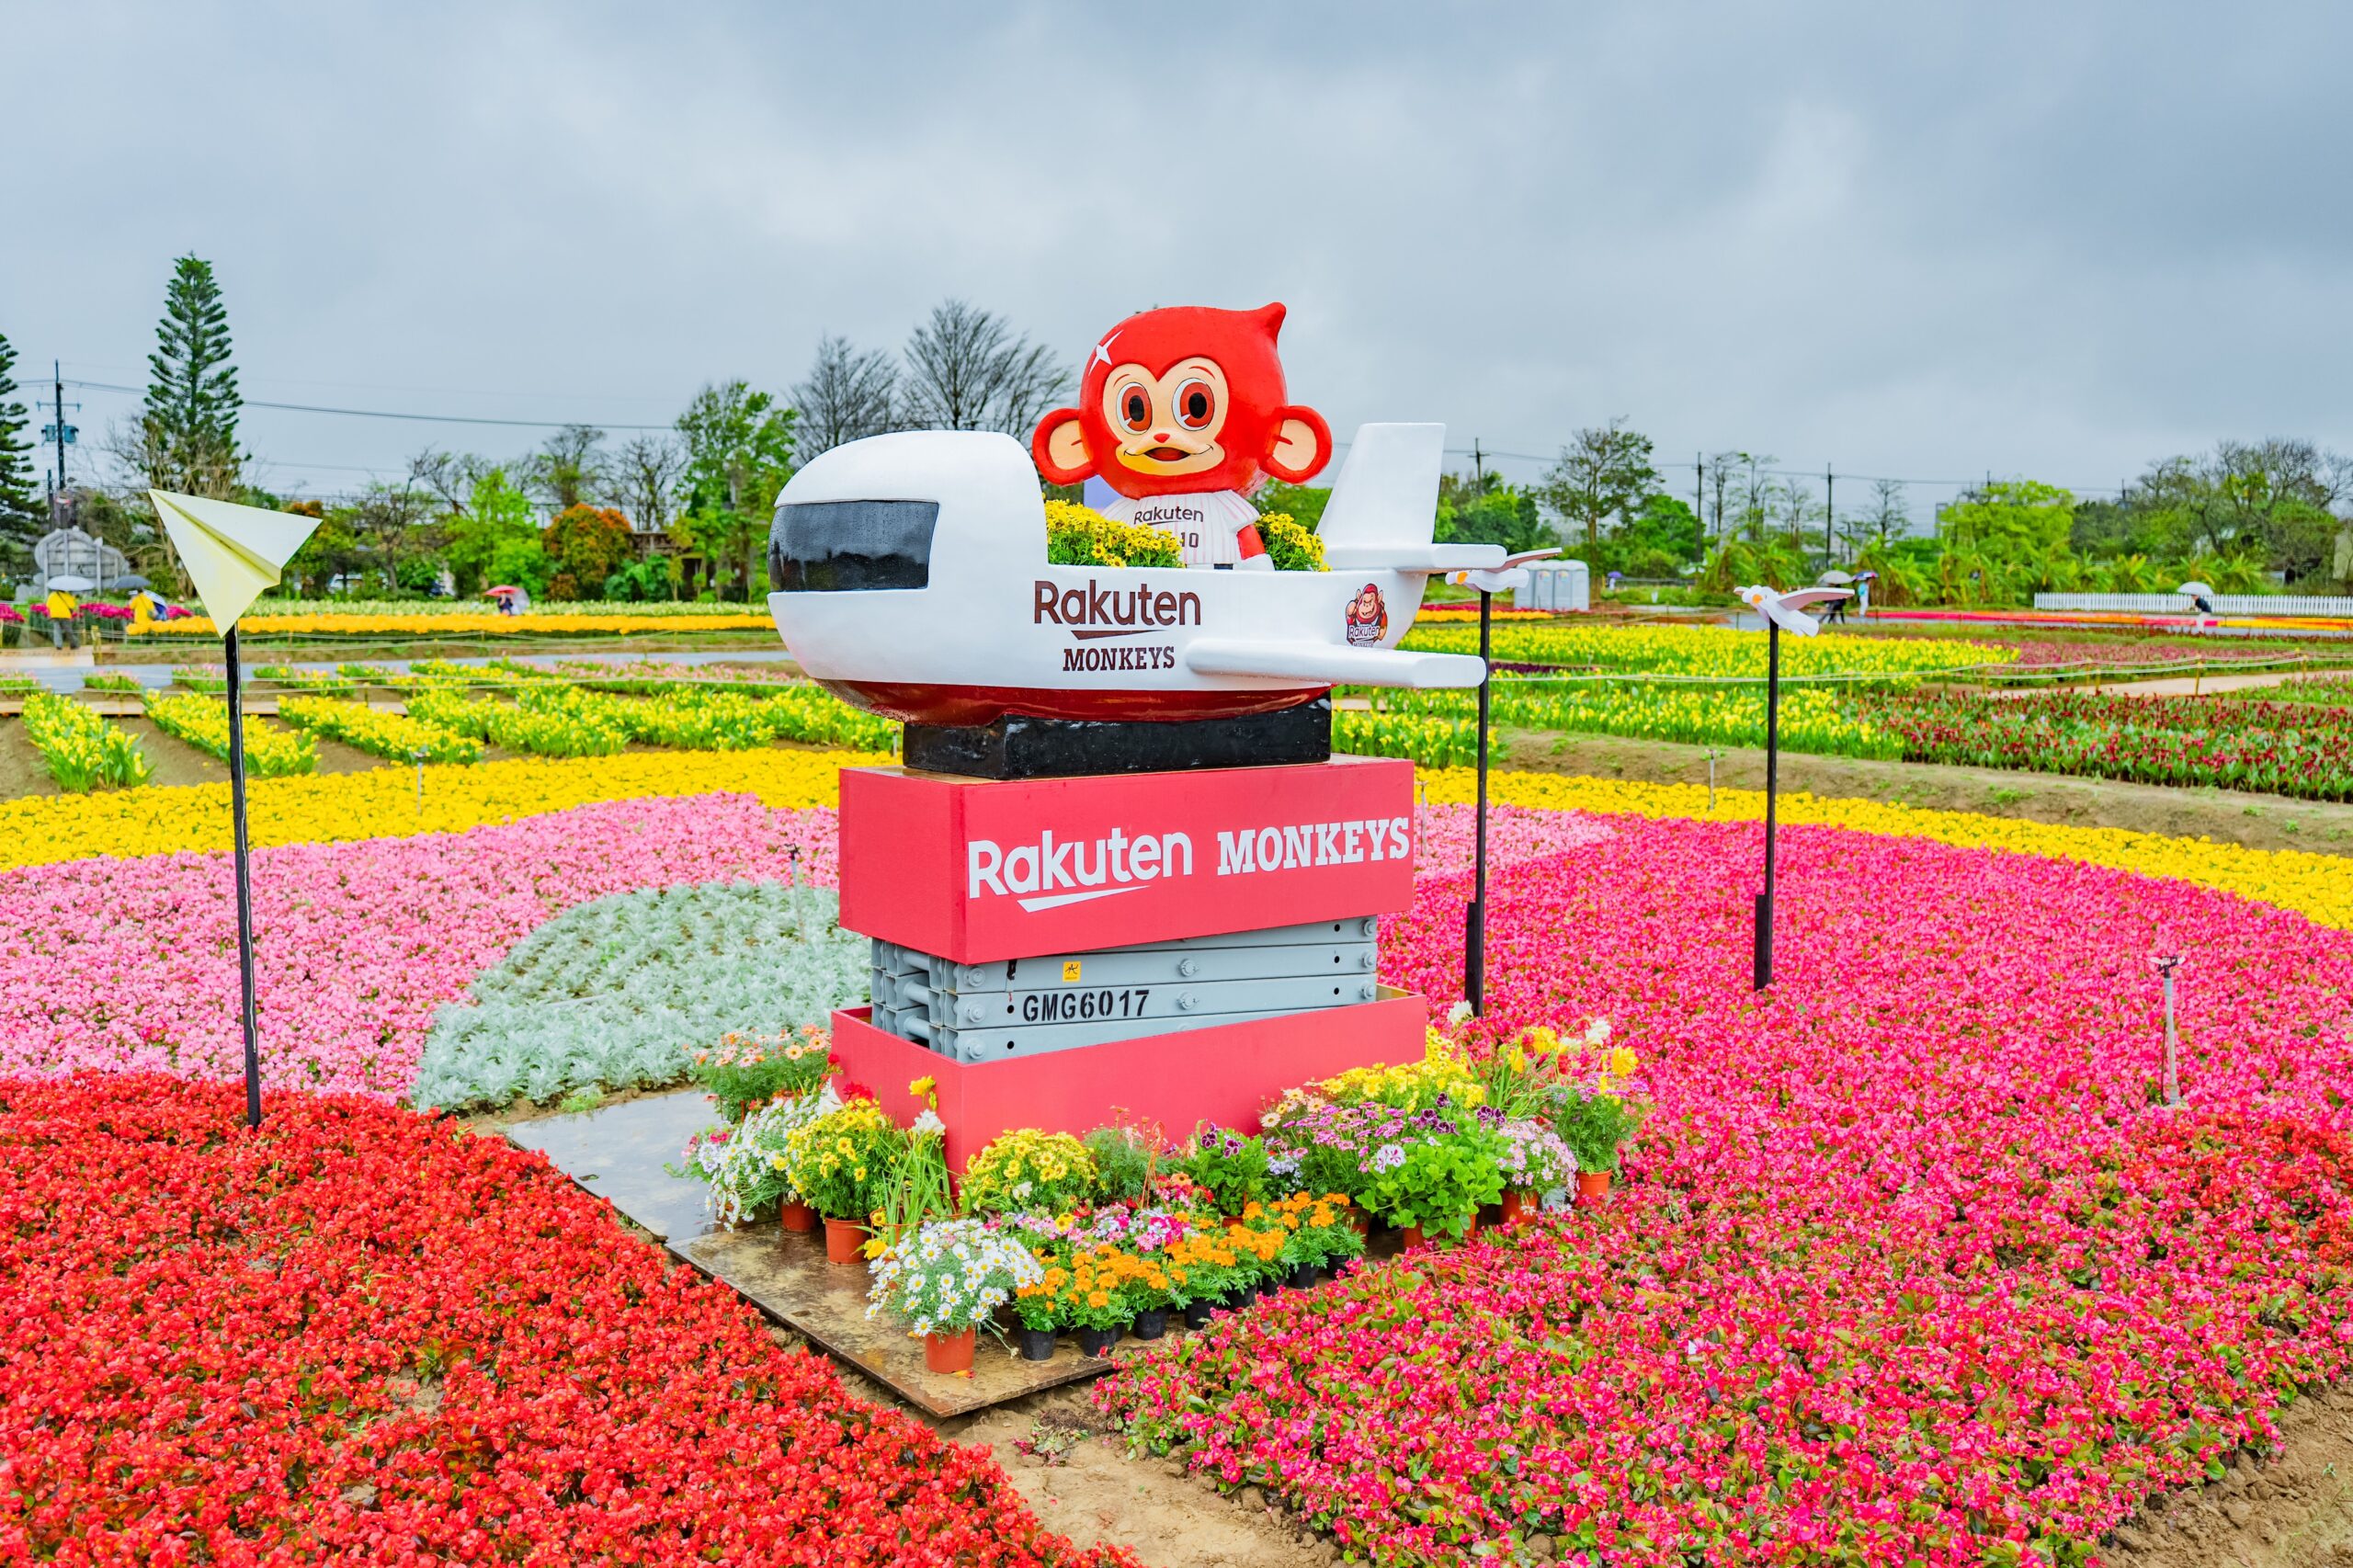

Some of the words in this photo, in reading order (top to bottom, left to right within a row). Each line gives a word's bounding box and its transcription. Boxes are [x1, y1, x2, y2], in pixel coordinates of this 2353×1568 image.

[1133, 506, 1204, 525] Rakuten
[1180, 531, 1199, 549] 10
[1034, 579, 1201, 626] Rakuten
[1063, 645, 1176, 672] MONKEYS
[968, 827, 1193, 899] Rakuten
[1217, 816, 1410, 876] MONKEYS
[1023, 989, 1150, 1022] GMG6017
